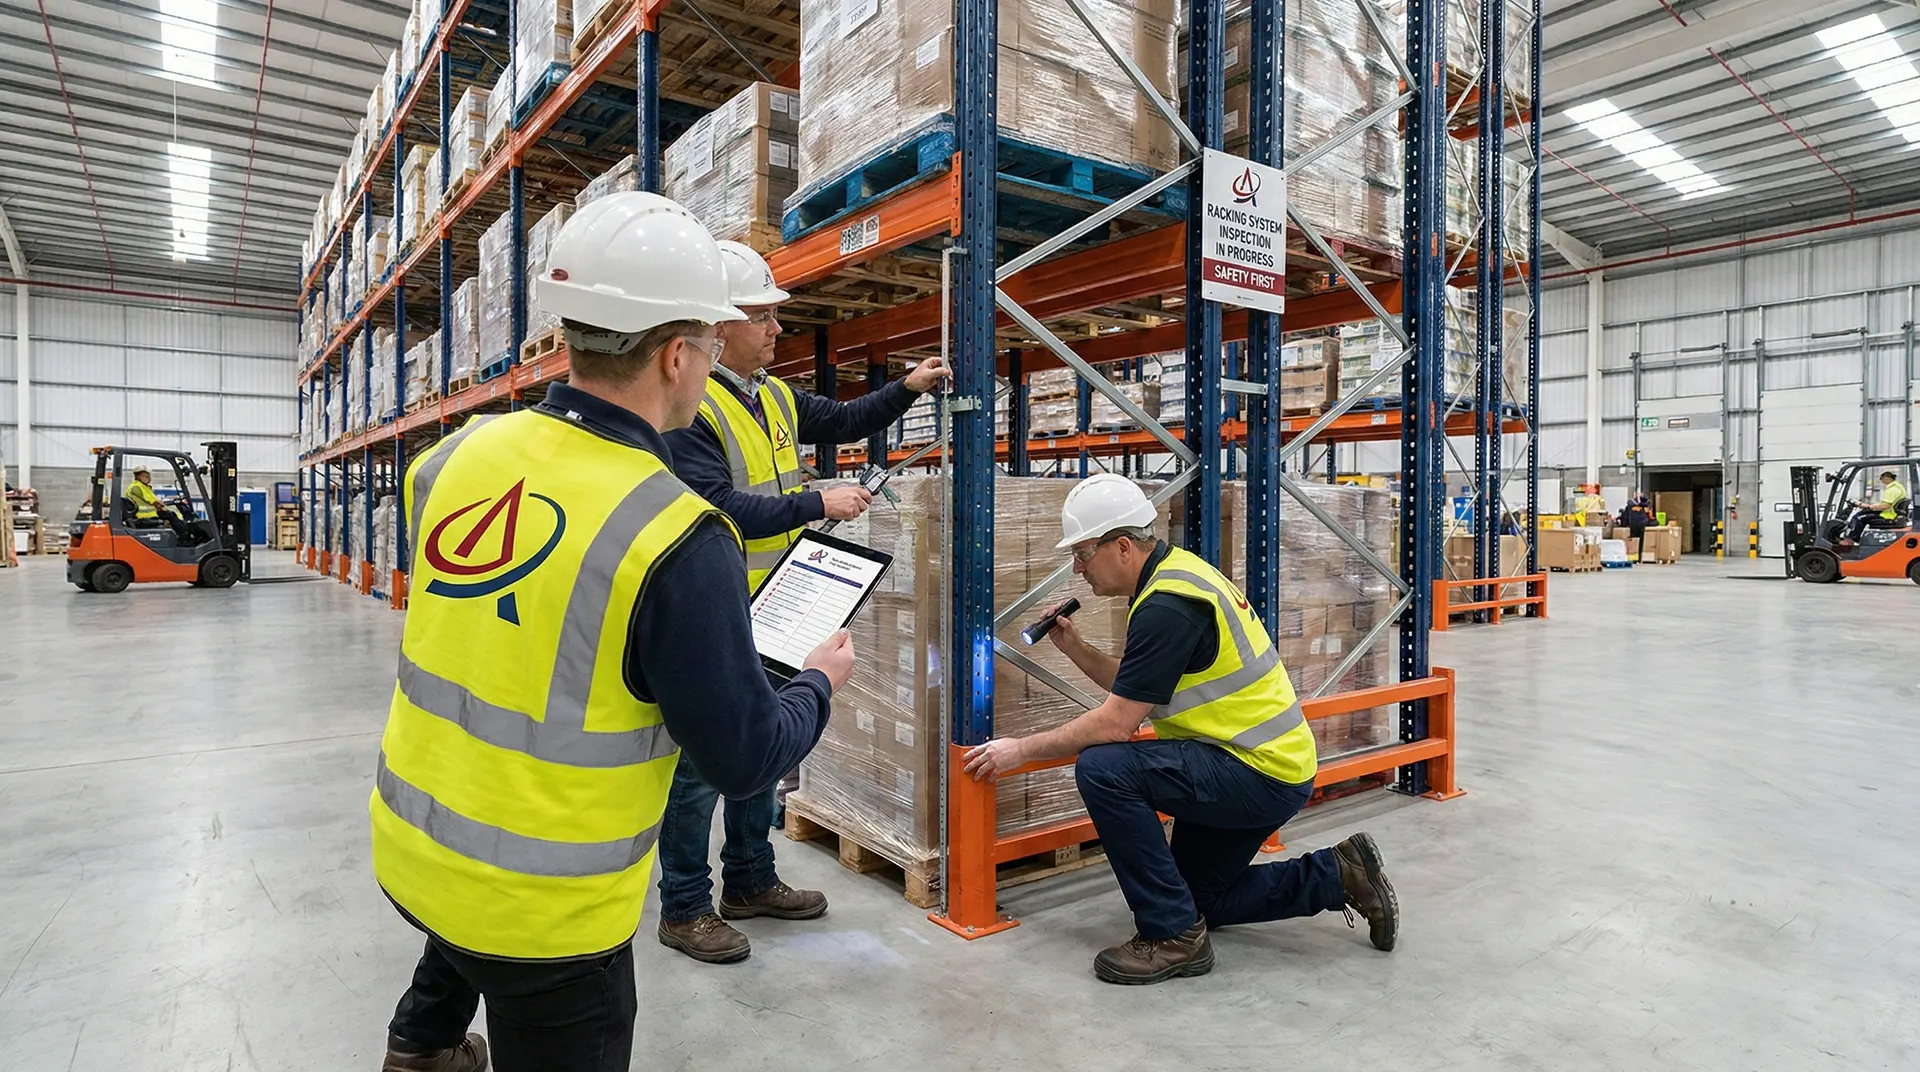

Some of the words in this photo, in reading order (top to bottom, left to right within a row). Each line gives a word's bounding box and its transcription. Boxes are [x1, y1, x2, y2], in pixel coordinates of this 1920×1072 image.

[1207, 203, 1247, 226] RACKING
[1248, 215, 1282, 235] SYSTEM
[1219, 225, 1271, 249] INSPECTION
[1215, 242, 1225, 256] IN
[1227, 245, 1274, 268] PROGRESS
[1214, 264, 1249, 284] SAFETY
[1250, 272, 1275, 290] FIRST
